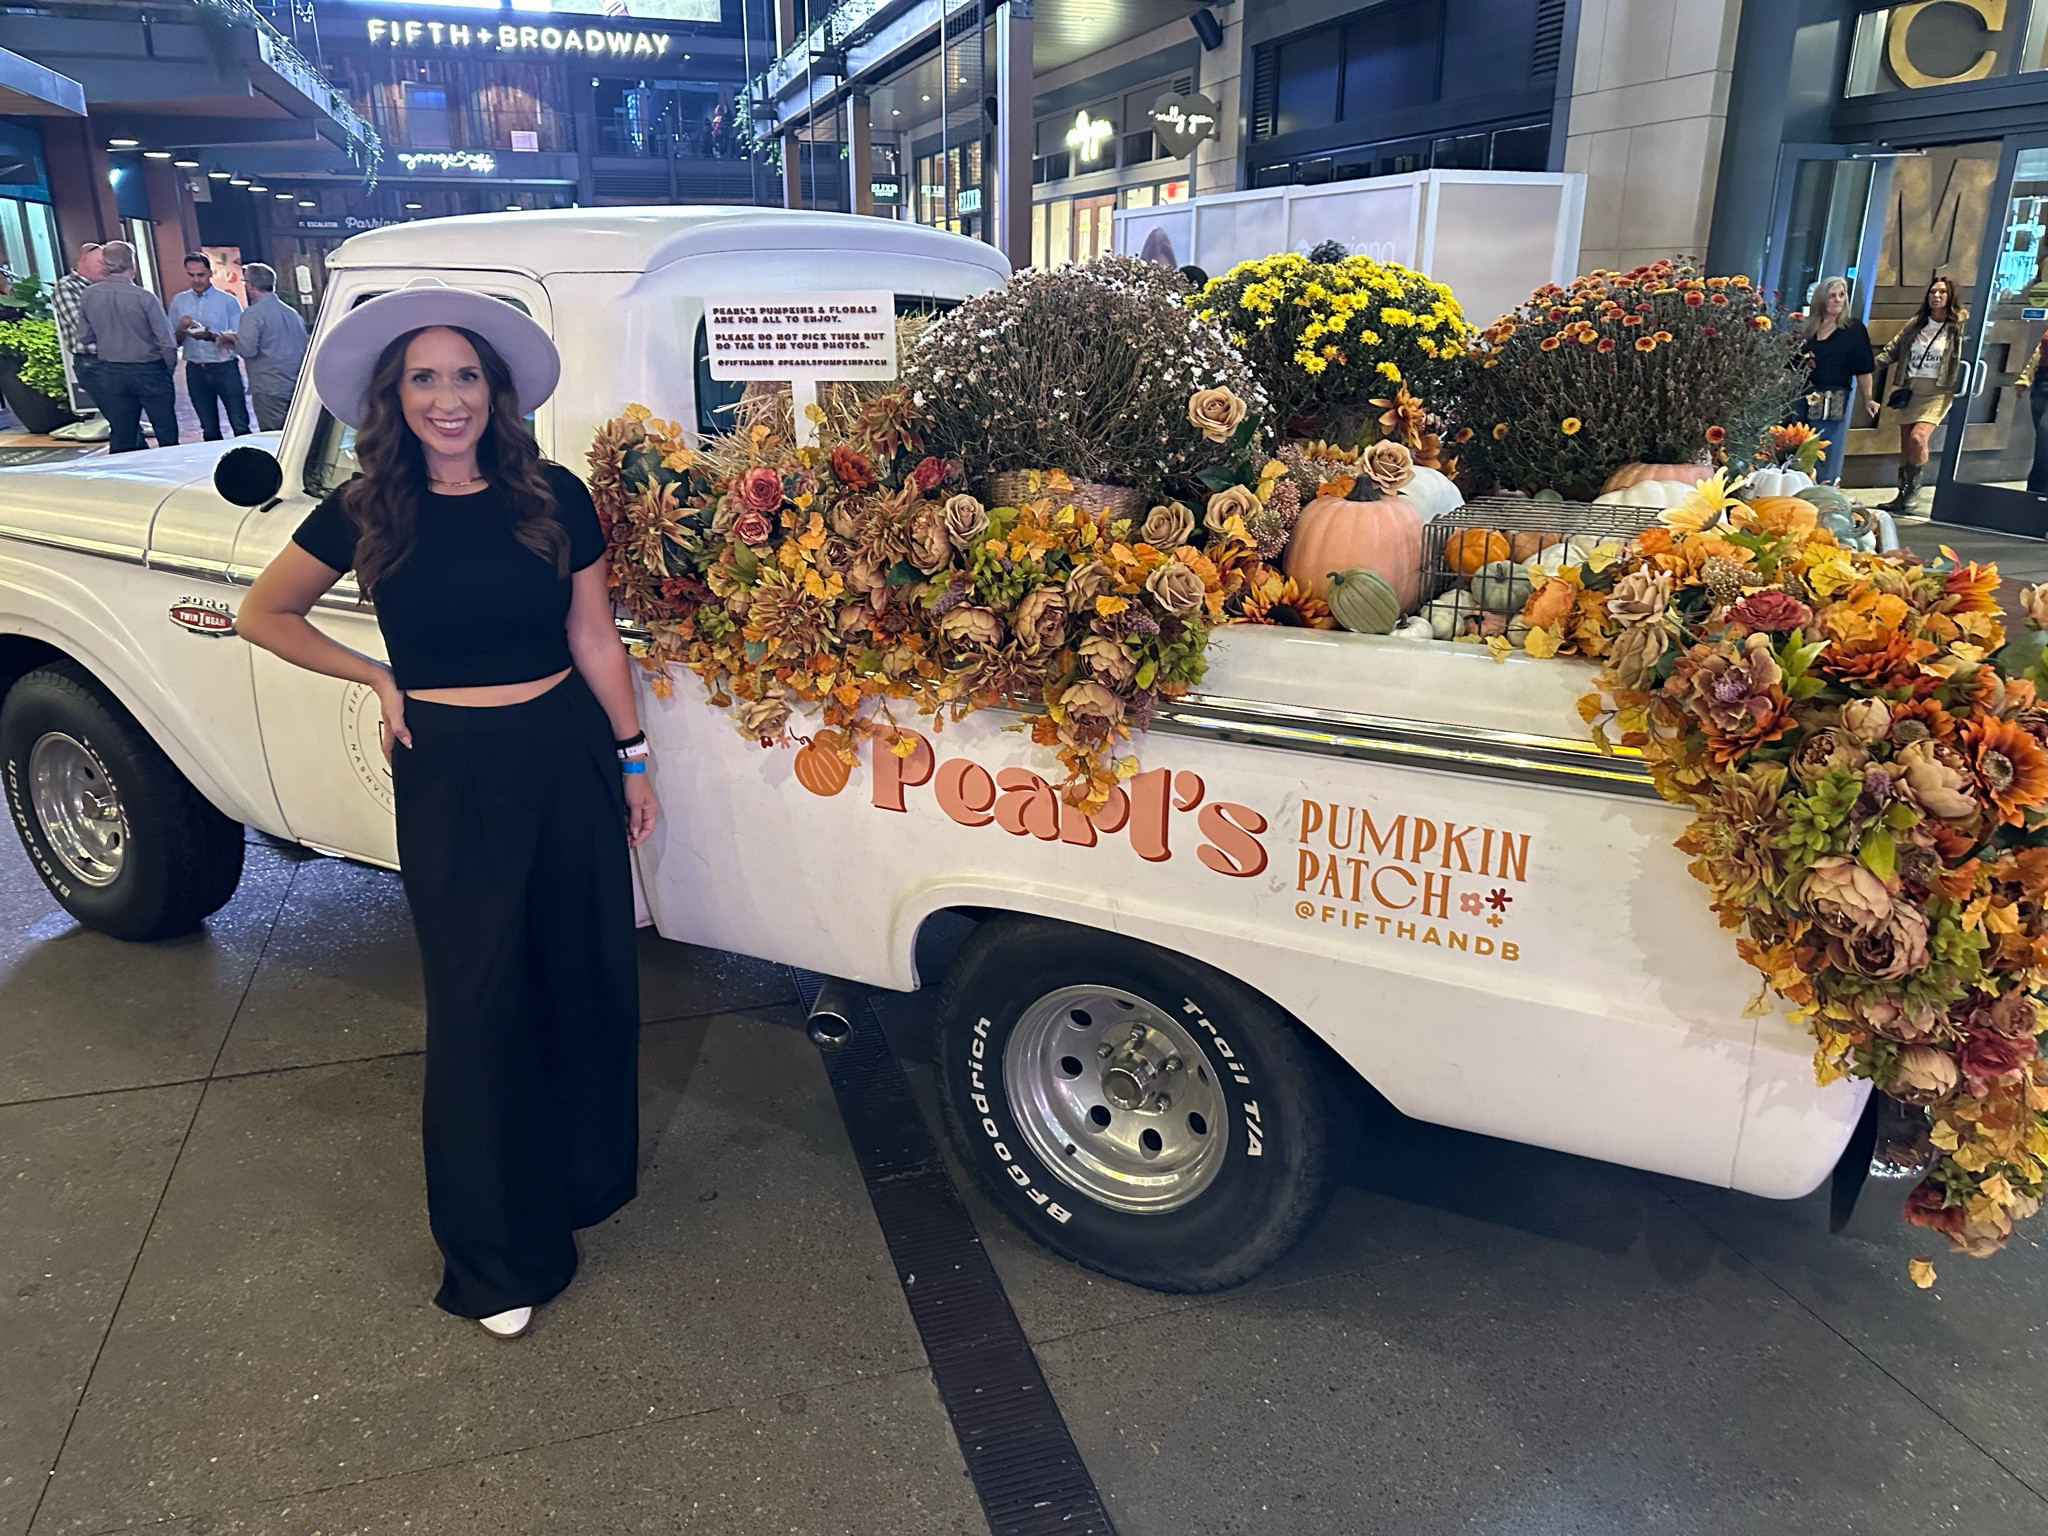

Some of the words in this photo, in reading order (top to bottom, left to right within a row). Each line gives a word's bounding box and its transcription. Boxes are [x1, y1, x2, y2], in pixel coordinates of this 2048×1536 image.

[367, 19, 470, 45] FIFTH
[499, 25, 670, 54] BROADWAY
[712, 307, 756, 315] PEARL'S
[760, 306, 814, 315] PUMPKINS
[818, 306, 825, 314] &
[829, 305, 877, 314] FLORALS
[714, 316, 734, 324] ARE
[738, 316, 758, 324] FOR
[786, 315, 799, 323] TO
[803, 315, 841, 323] ENJOY.
[715, 333, 754, 341] PLEASE
[758, 333, 772, 341] DO
[776, 333, 798, 341] NOT
[802, 333, 827, 341] PICK
[863, 332, 885, 340] BUT
[716, 342, 730, 350] DO
[734, 342, 754, 350] TAG
[758, 342, 772, 350] US
[775, 342, 787, 350] IN
[822, 341, 870, 349] PHOTOS.
[179, 595, 228, 611] FORD
[180, 611, 198, 622] TWIN
[205, 616, 226, 627] BEAM
[348, 683, 364, 713] FIFT
[350, 743, 392, 805] NASHVIL
[870, 722, 1269, 879] Pearl's
[7, 759, 71, 898] BFGoodrich
[1298, 798, 1532, 883] PUMPKIN
[1296, 848, 1452, 920] PATCH
[1295, 900, 1520, 962] @FIFTHANDB
[1182, 997, 1250, 1085] Trail
[1243, 1100, 1262, 1157] T/A
[967, 1016, 1072, 1224] BFGoodrich
